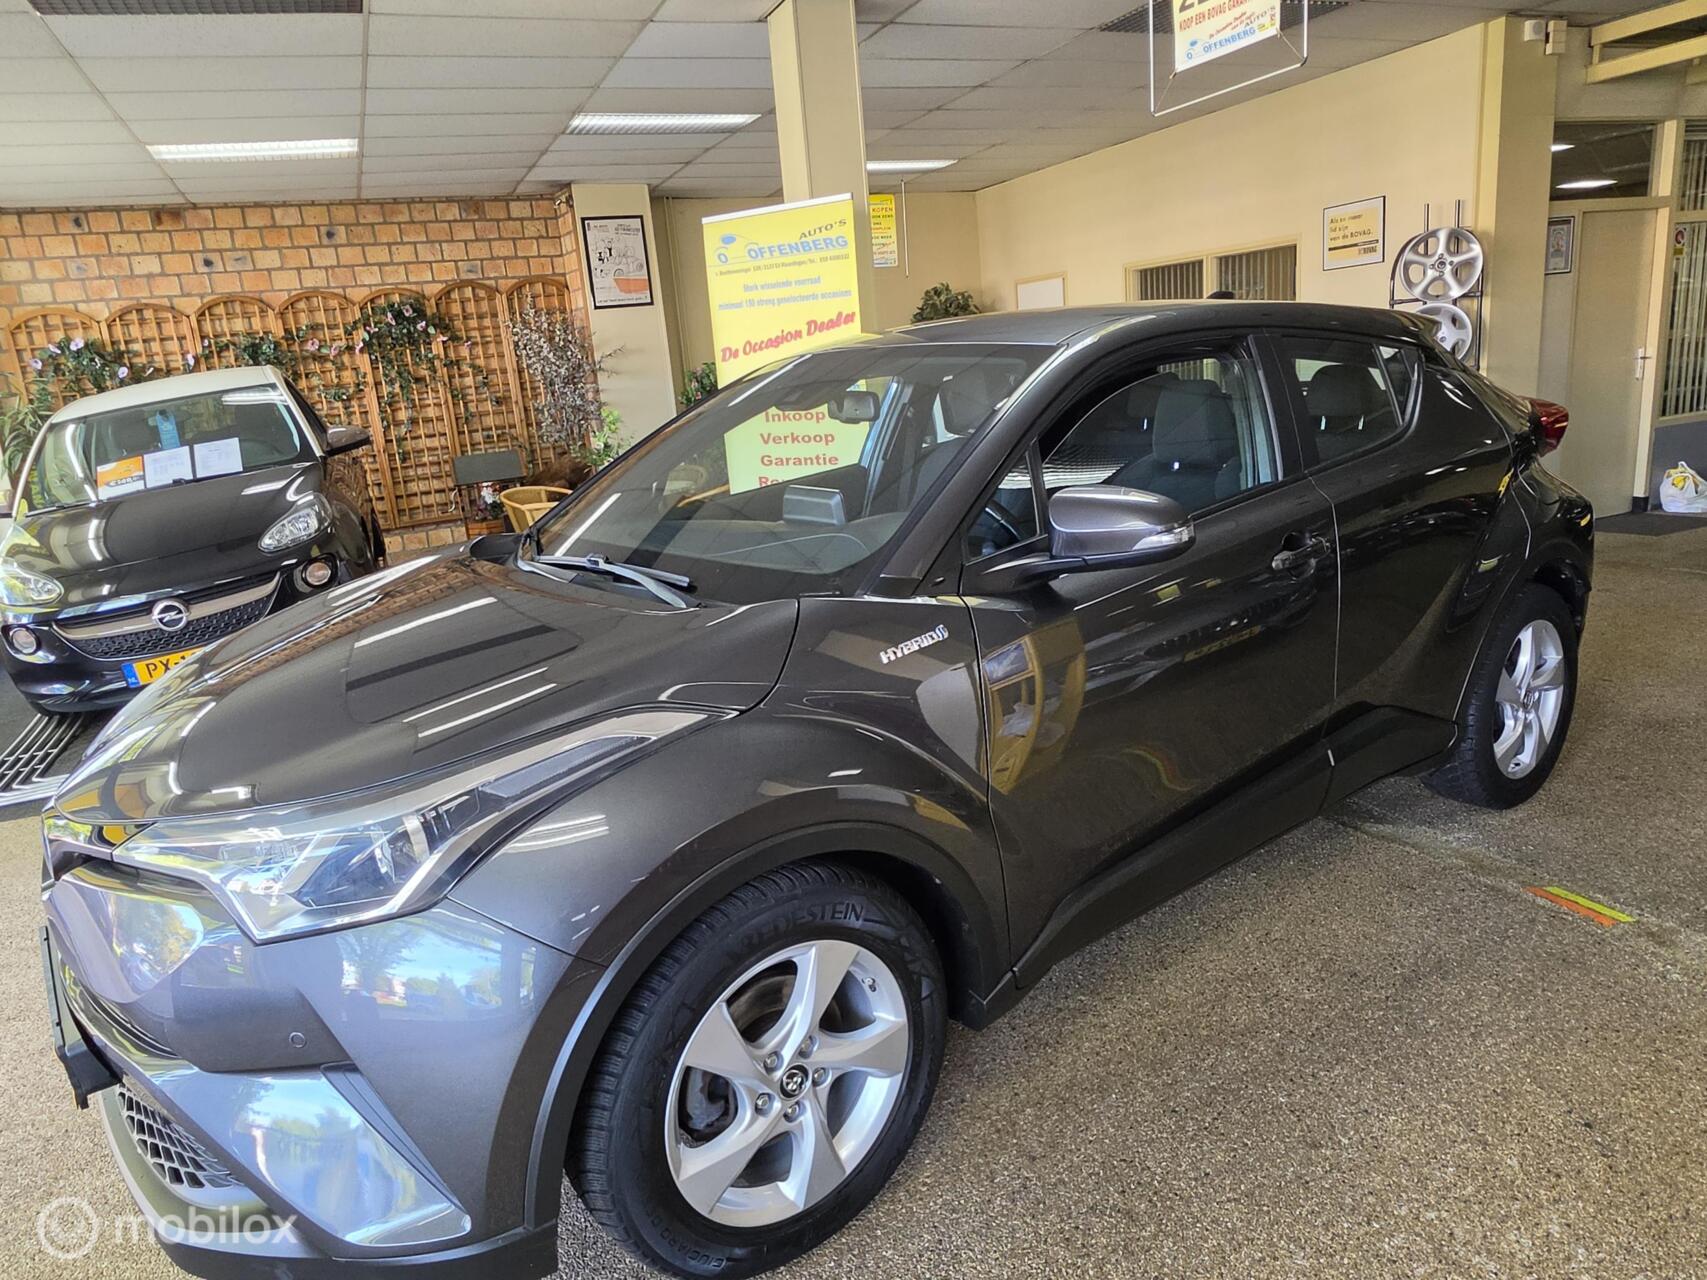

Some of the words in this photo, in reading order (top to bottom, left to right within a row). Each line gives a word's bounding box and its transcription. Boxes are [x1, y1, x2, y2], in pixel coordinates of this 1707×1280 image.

[1178, 16, 1194, 32] KOOP
[1195, 12, 1206, 26] EEN
[1207, 2, 1227, 20] BOVAG
[1203, 27, 1256, 54] OFFENBERG
[799, 218, 847, 240] AUTO'S
[747, 235, 849, 260] OFFENBERG
[720, 346, 739, 362] De
[742, 328, 803, 355] Occasion
[805, 311, 856, 337] Dealer
[764, 410, 826, 423] Inkoop
[760, 432, 835, 446] Verkoop
[760, 453, 839, 467] Garantie
